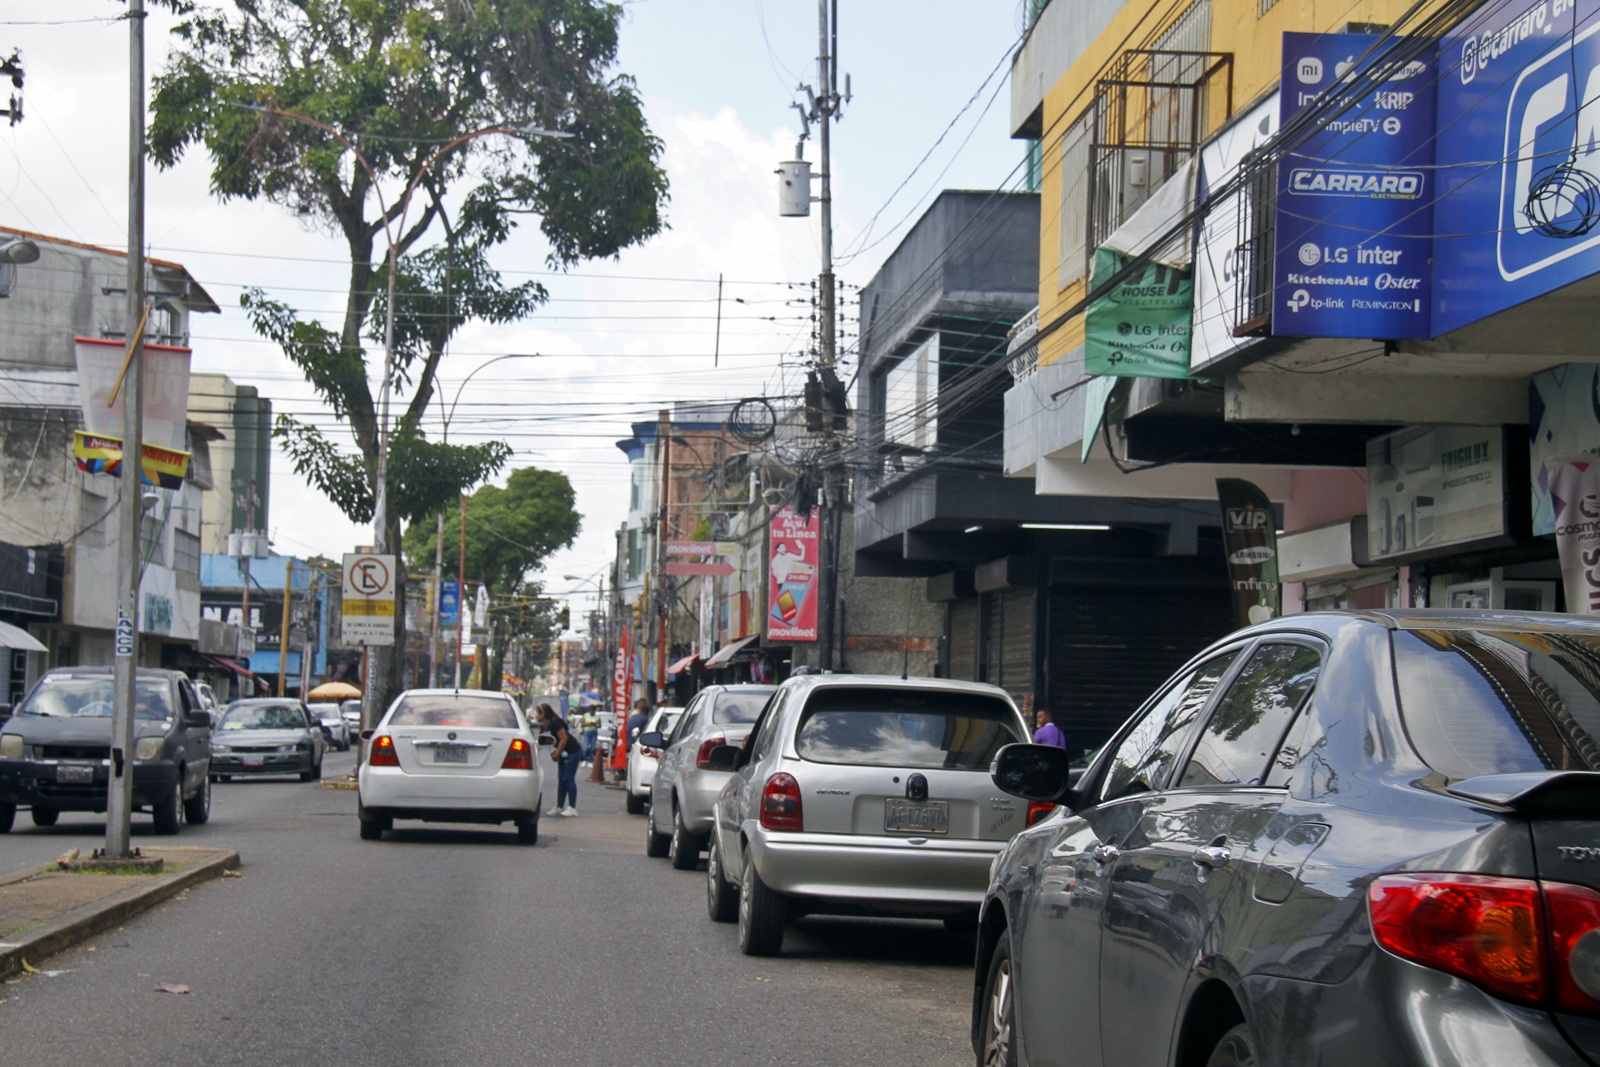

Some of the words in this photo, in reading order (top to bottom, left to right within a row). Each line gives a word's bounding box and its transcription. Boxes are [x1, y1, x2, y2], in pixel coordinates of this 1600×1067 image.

[1293, 171, 1418, 194] CARRARO
[1324, 247, 1348, 264] LG
[1357, 245, 1402, 265] inter
[1287, 273, 1369, 286] KitchenAid
[1374, 272, 1421, 291] Oster
[1121, 286, 1165, 298] HOUSE
[1310, 297, 1344, 310] tp-link
[1352, 299, 1412, 310] REMINGTON
[1134, 324, 1152, 336] LG
[1107, 340, 1166, 351] KitchenAid
[1229, 510, 1267, 530] VIP
[773, 528, 785, 538] tu
[667, 543, 712, 554] movilnet
[362, 564, 376, 589] E
[769, 627, 815, 638] movilnet
[1557, 845, 1600, 861] TOY
